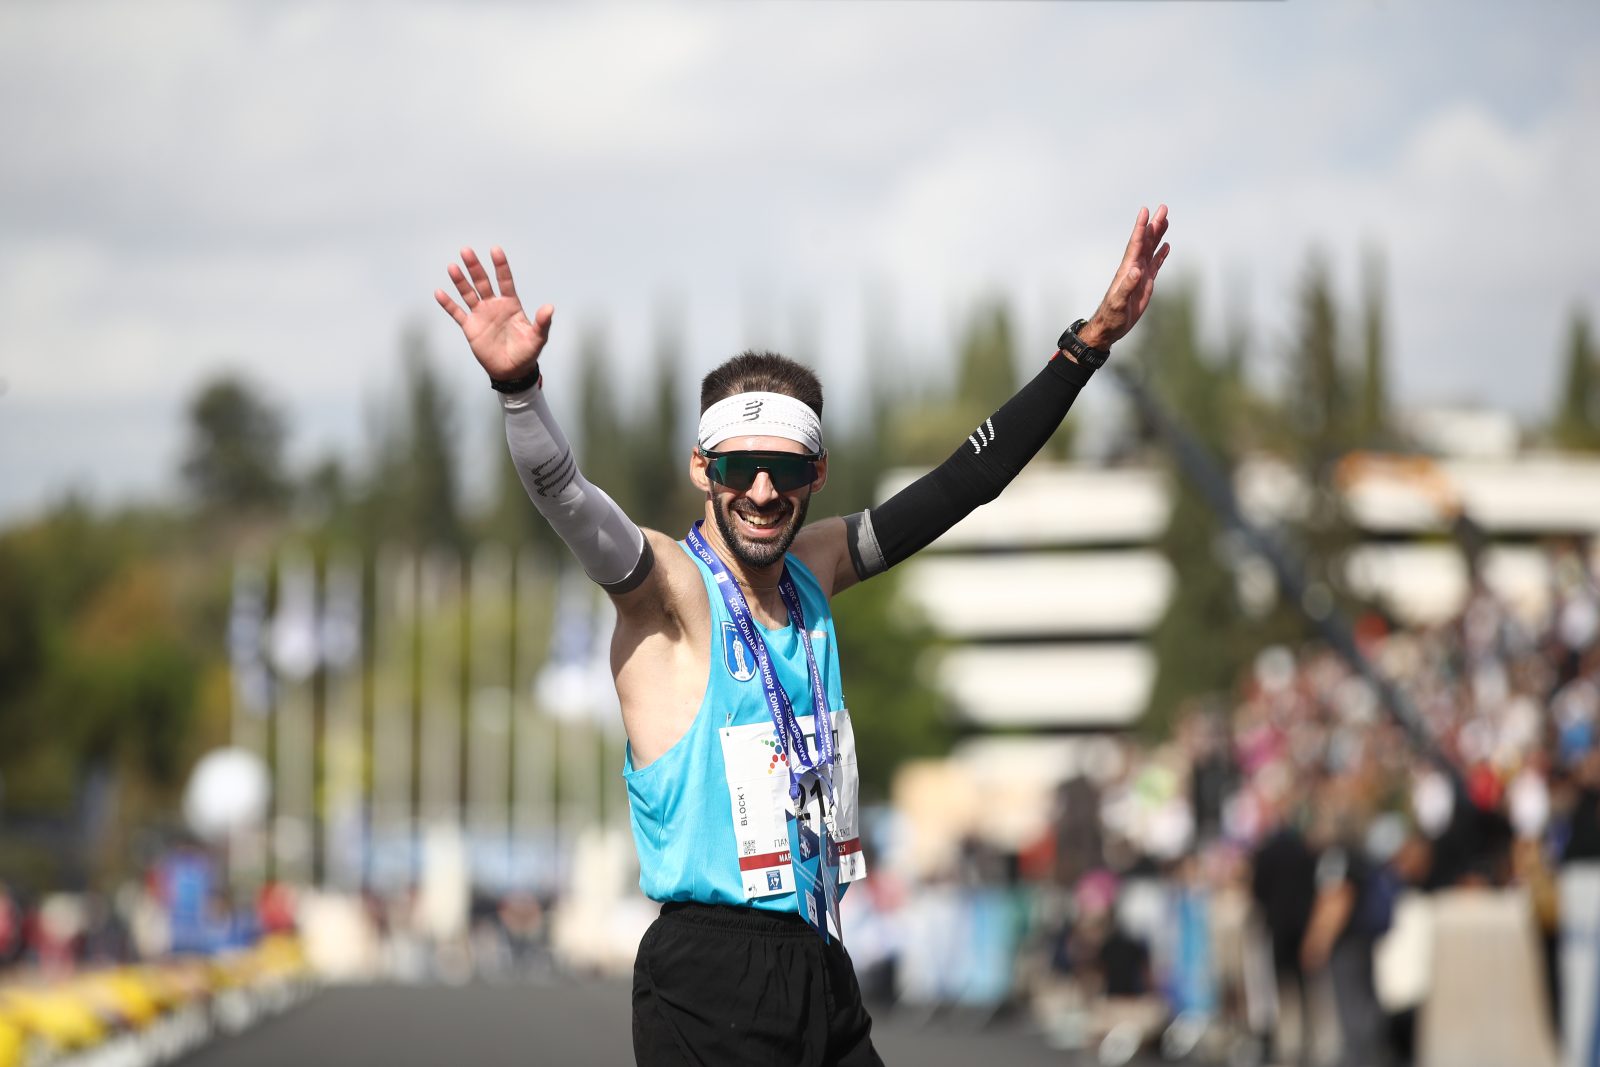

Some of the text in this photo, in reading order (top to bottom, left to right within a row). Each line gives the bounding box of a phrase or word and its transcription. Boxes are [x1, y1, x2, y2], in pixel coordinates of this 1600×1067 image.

[699, 549, 714, 565] 2025
[729, 597, 743, 617] 2025
[738, 616, 759, 657] ΘΕΝΤΙΚΟΣ
[738, 793, 748, 827] BLOCK
